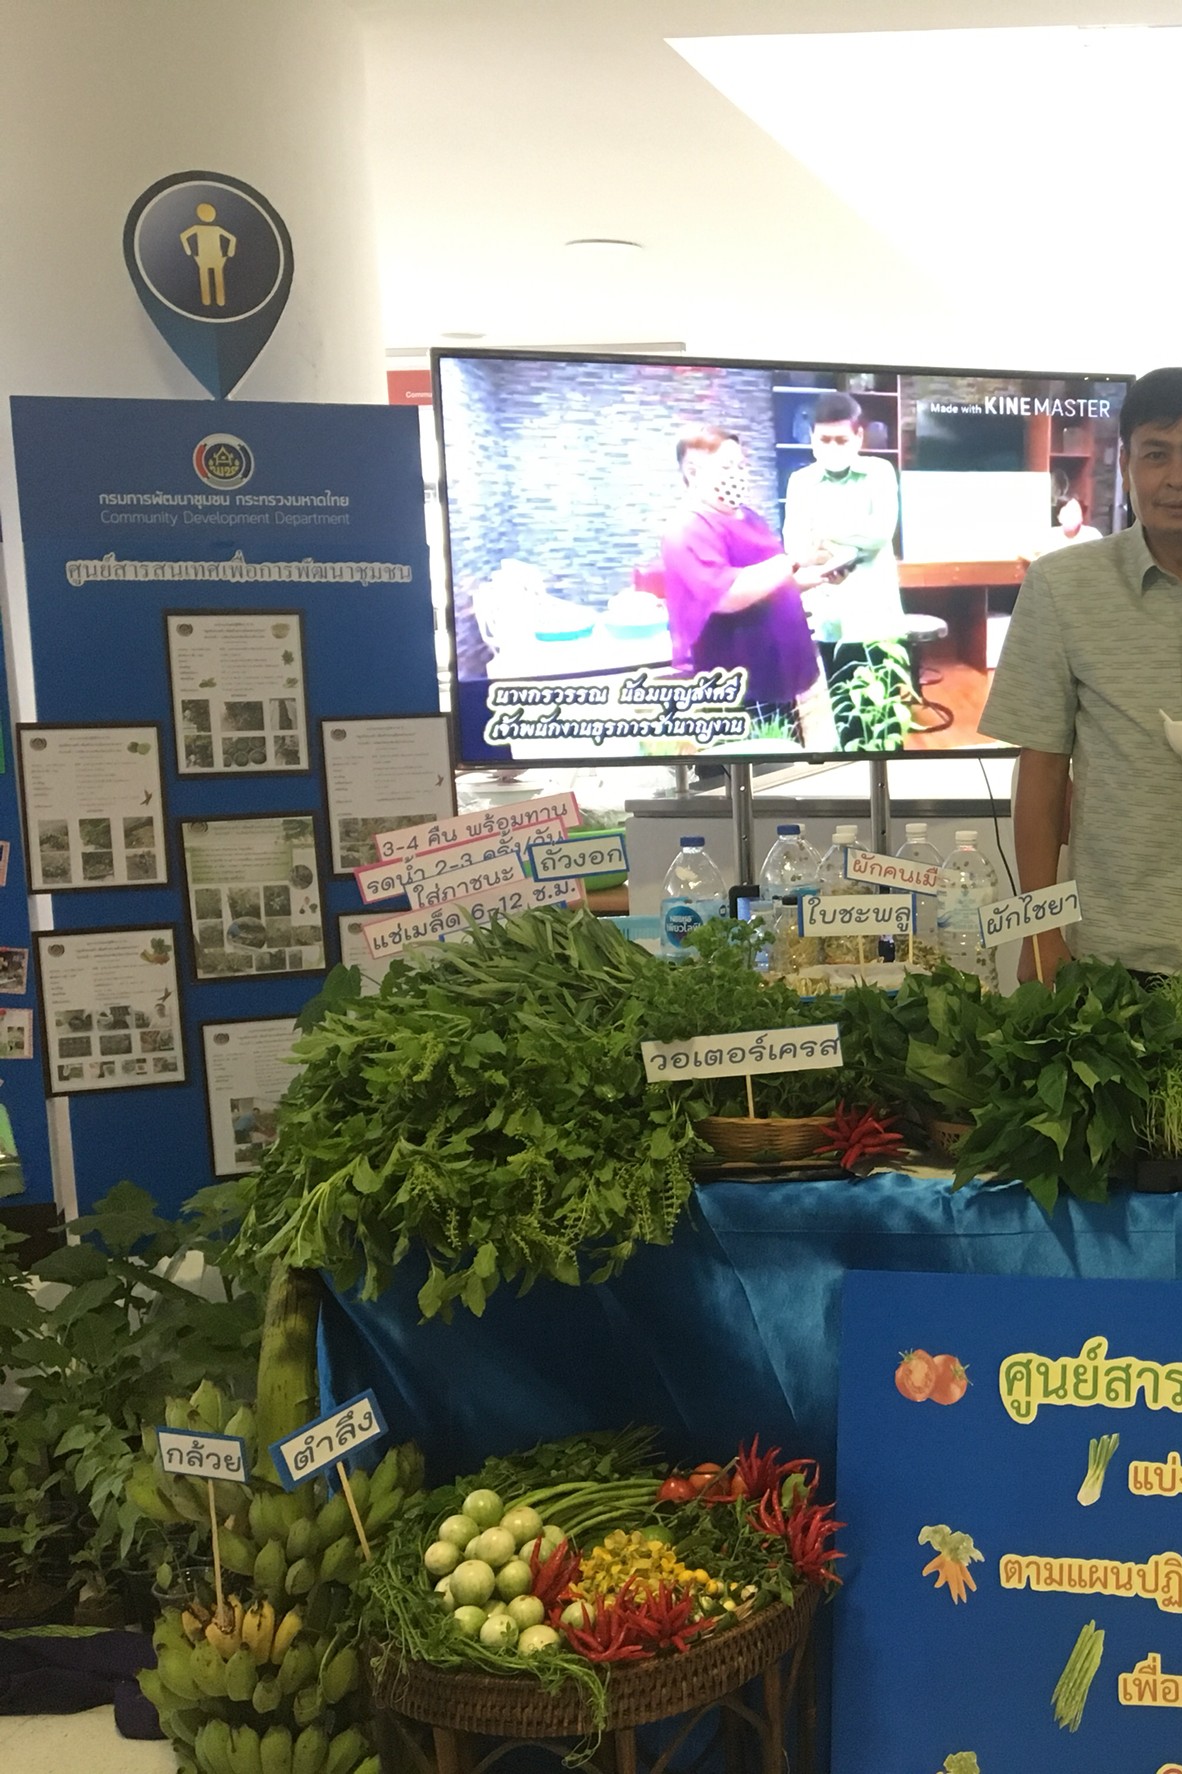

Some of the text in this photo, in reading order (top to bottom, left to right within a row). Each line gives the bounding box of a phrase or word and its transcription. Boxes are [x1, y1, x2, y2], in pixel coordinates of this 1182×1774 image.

[930, 396, 1111, 418] Made with KINEMASTER
[100, 490, 350, 509] กรมการพัฒนาชุมชน กระทรวงมหาดไทย
[101, 510, 350, 527] Community Development Department
[67, 552, 411, 585] ศูนย์สารสนเทศเพื่อการพัฒนาชุมชน
[382, 802, 568, 857] 3-4 คืน พร้อมทาน
[367, 854, 426, 895] รดน้ำ
[413, 865, 515, 909] ใส่ภาชนะ
[373, 908, 461, 951] แช่เมล็ด
[807, 897, 912, 932] ใบชะพลู
[987, 892, 1080, 935] ผักไชยา
[650, 1034, 840, 1072] วอเตอร์เครส
[166, 1440, 242, 1473] กล้วย
[293, 1411, 373, 1471] ตำลึง
